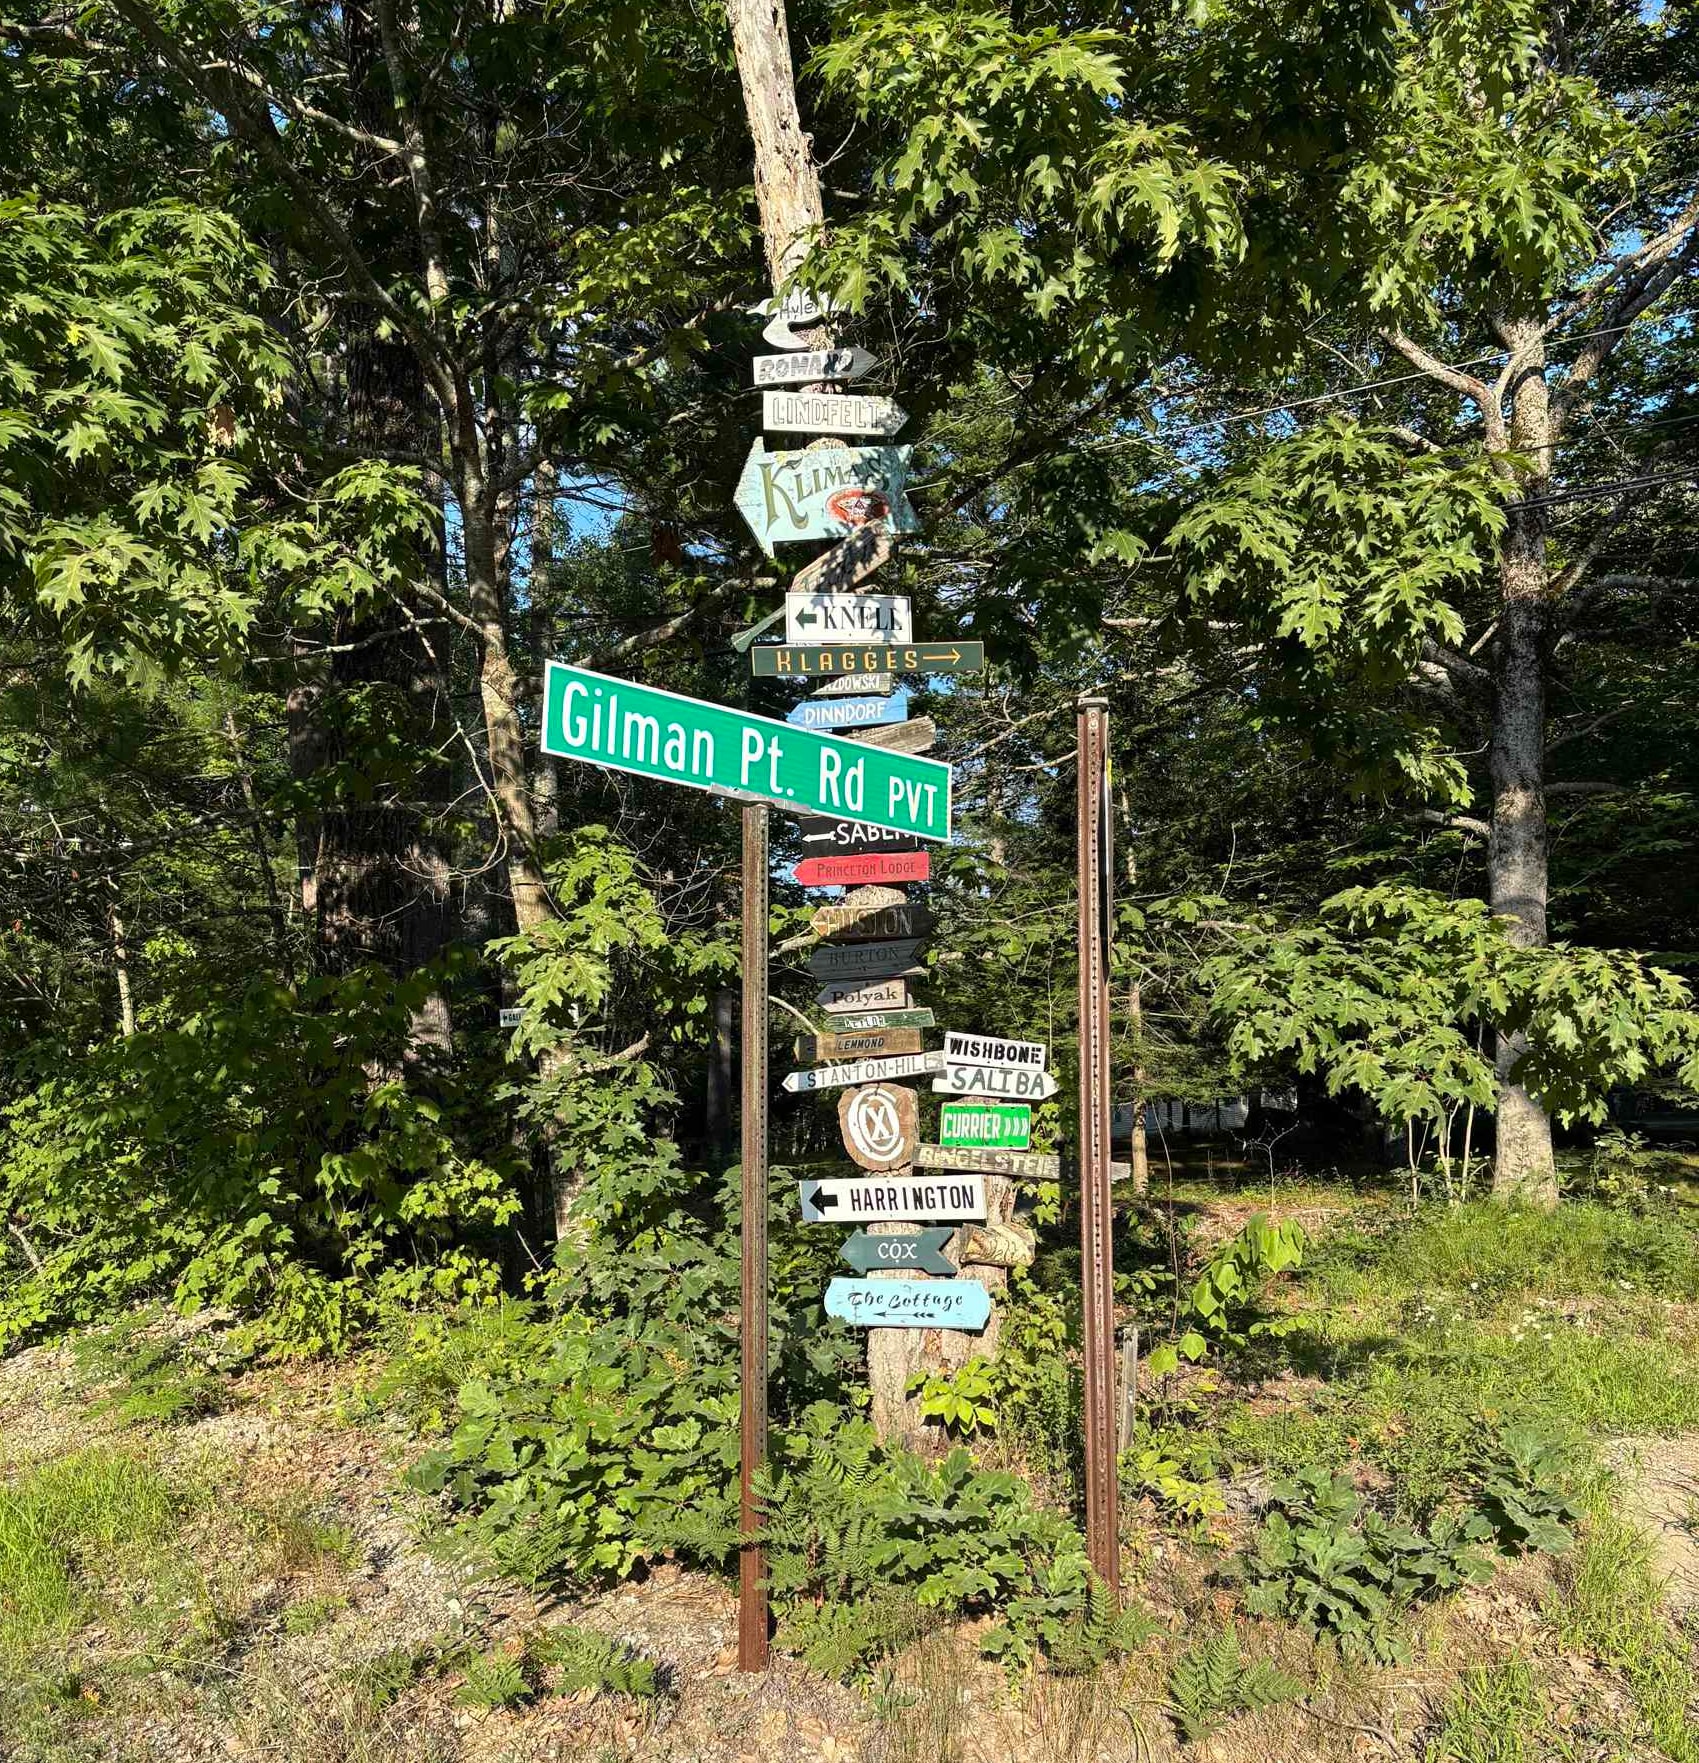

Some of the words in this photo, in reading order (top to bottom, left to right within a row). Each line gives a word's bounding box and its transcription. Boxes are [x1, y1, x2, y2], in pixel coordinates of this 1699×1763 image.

[772, 396, 880, 429] LINDFELT
[823, 605, 903, 631] KNELL
[776, 650, 918, 673] KLAGGES
[803, 701, 887, 725] DINNDORF
[562, 680, 715, 778] Gilman
[740, 726, 795, 797] Pt.
[818, 747, 865, 812] Rd
[888, 775, 939, 828] PVT
[830, 987, 898, 1007] Polyak
[950, 1037, 1042, 1064] WISHBONE
[951, 1067, 1045, 1096] SALIBA
[943, 1112, 1000, 1139] CURRIER
[850, 1185, 974, 1212] HARRINGTON
[848, 1291, 884, 1306] The
